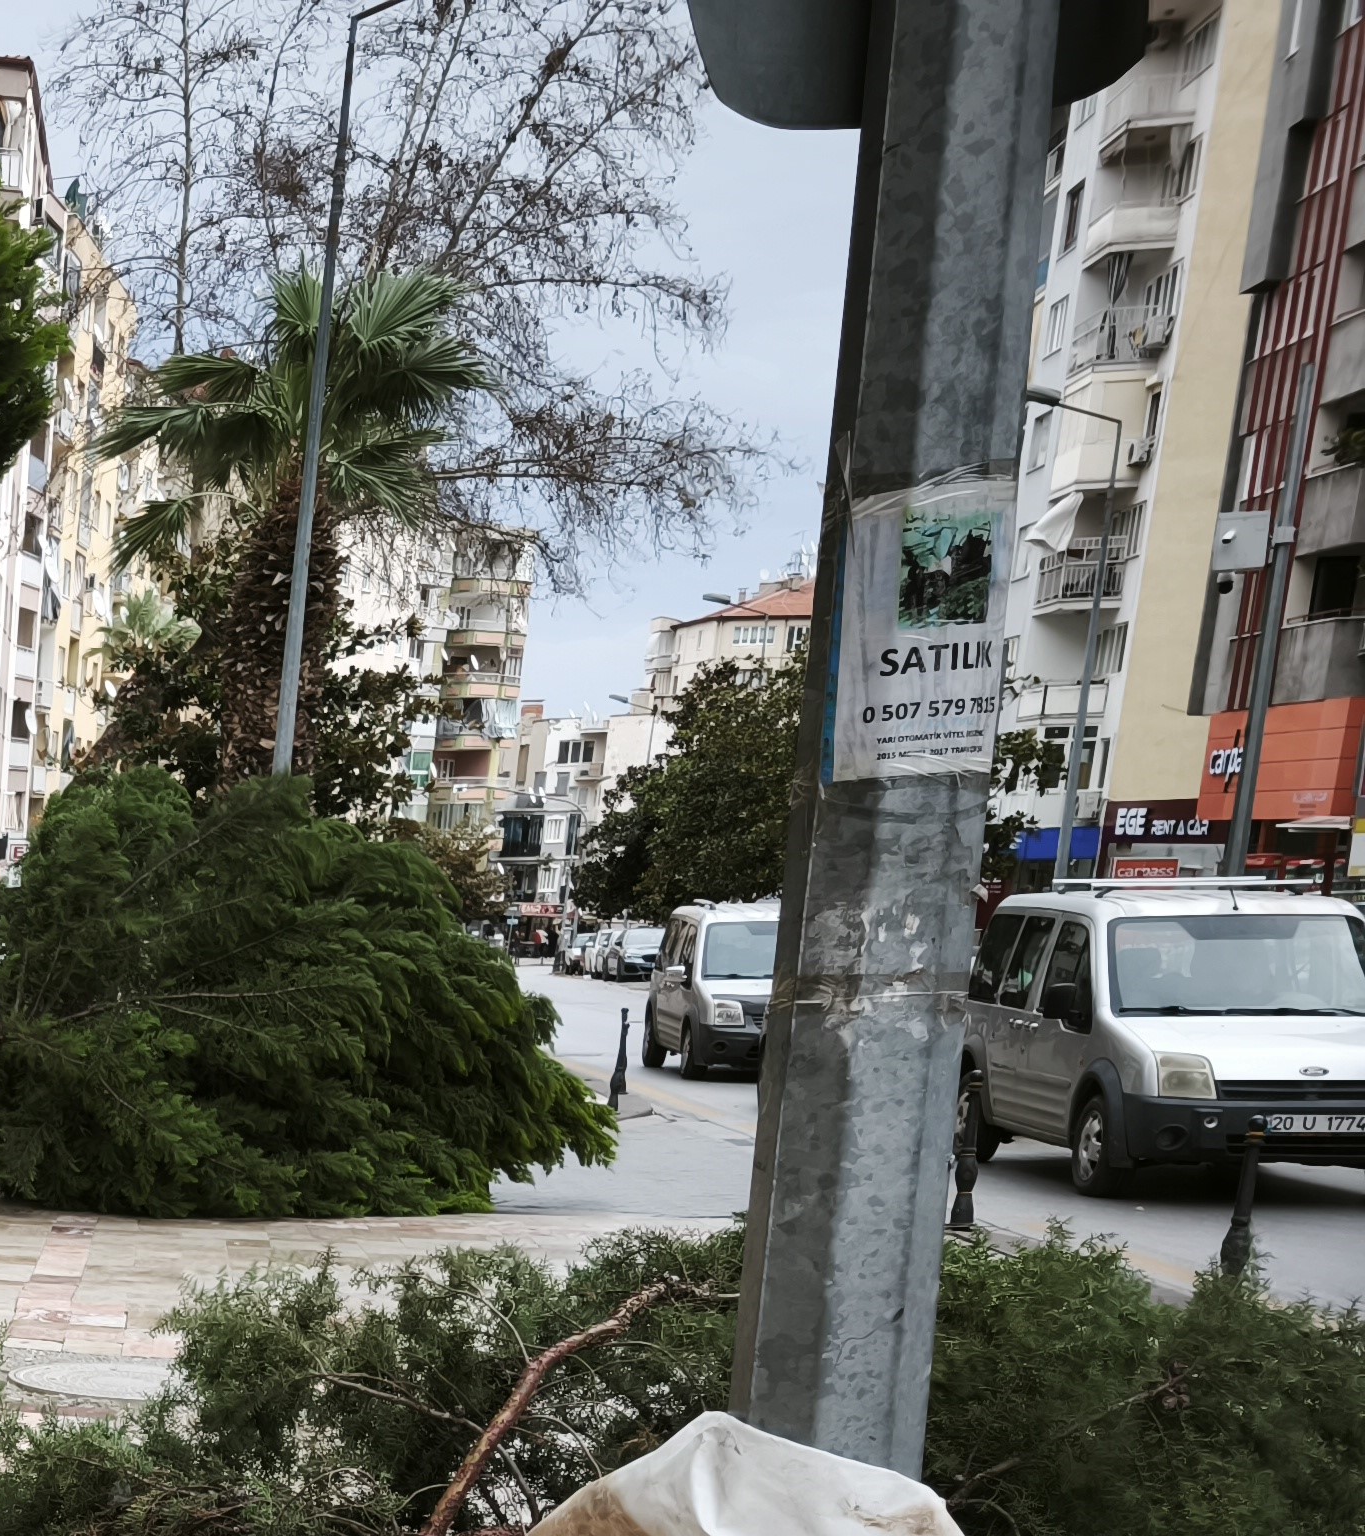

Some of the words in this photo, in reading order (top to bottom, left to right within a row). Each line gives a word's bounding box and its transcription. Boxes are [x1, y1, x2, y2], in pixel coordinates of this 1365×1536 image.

[879, 640, 993, 677] SATILIK
[862, 706, 876, 724] 0
[881, 701, 922, 723] 507
[927, 698, 966, 718] 579
[1114, 807, 1148, 836] EGE
[1150, 819, 1177, 836] RENT
[1186, 815, 1210, 836] CAR
[1273, 1116, 1295, 1131] 20
[1302, 1116, 1317, 1131] U
[1327, 1116, 1365, 1131] 1774
